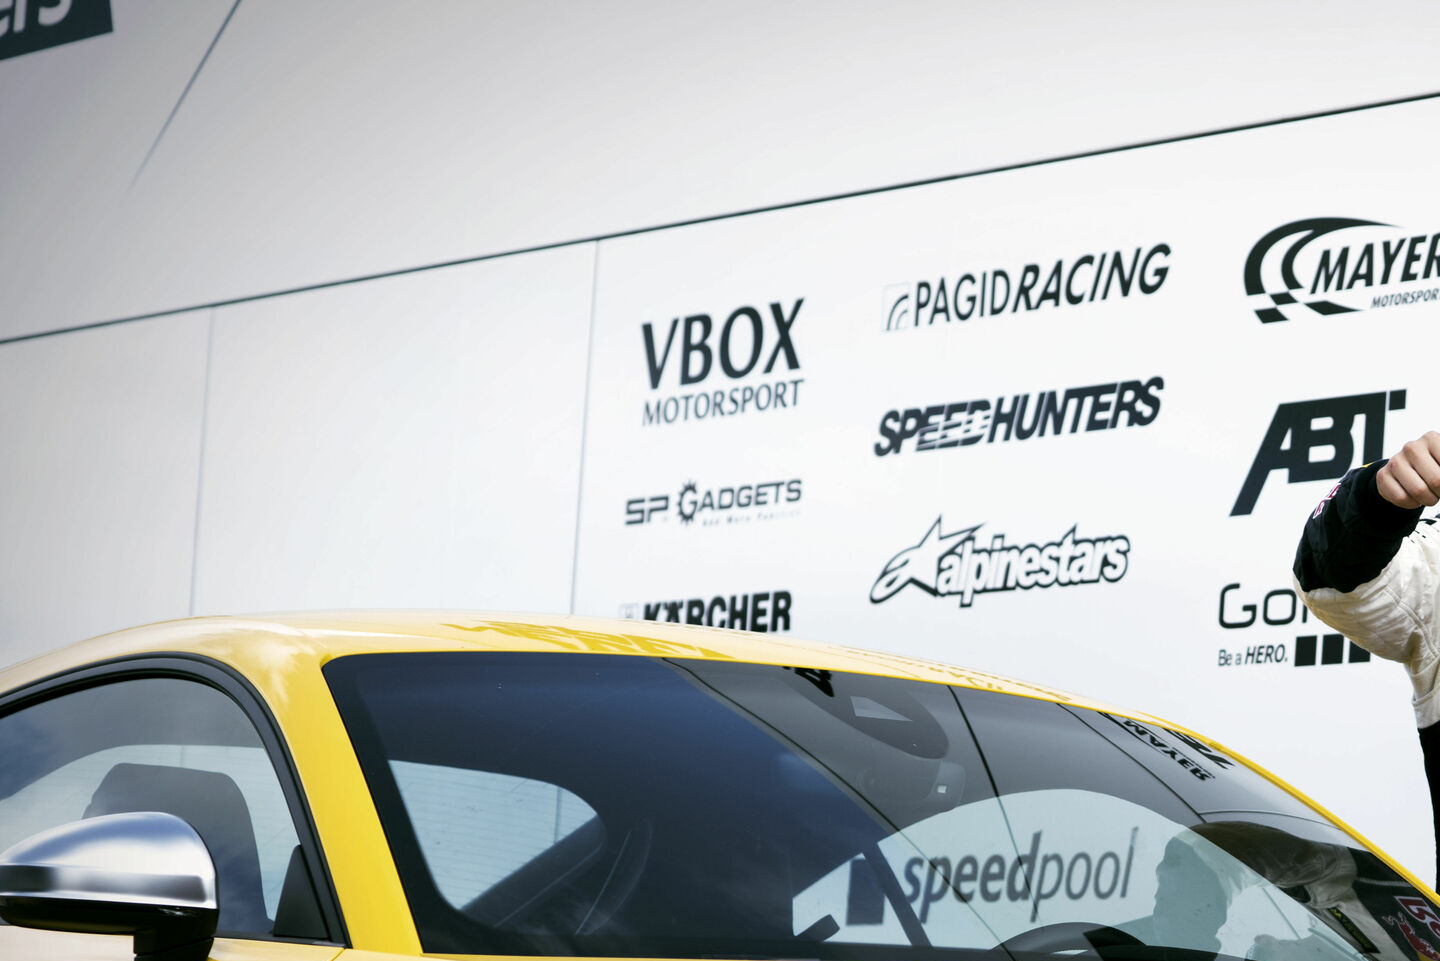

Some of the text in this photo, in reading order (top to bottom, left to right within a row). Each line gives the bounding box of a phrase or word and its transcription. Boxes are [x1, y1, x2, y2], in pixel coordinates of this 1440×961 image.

[642, 298, 804, 390] VBOX
[643, 378, 805, 427] MOTORSPORT
[874, 376, 1165, 457] SPEEDHUNTERS
[1229, 388, 1407, 517] ABT
[676, 479, 803, 526] GADGETS
[936, 523, 1132, 609] alpinestars
[1218, 643, 1289, 667] Be a HERO.
[902, 825, 1140, 923] speedpool
